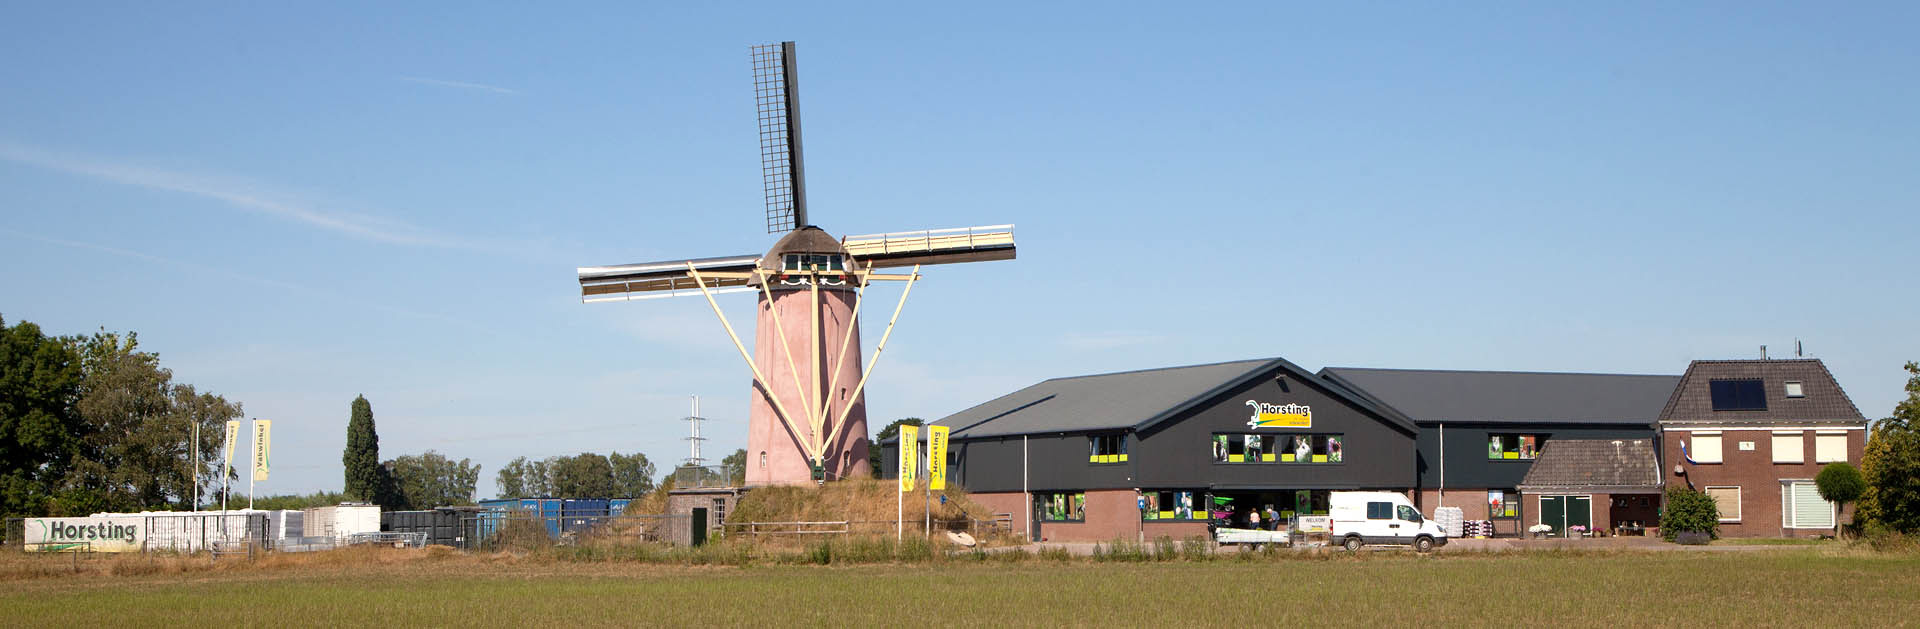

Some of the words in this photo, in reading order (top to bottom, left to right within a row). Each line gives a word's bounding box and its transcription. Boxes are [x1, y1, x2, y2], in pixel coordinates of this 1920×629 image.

[1261, 403, 1308, 417] Horsting
[257, 424, 265, 468] Vakwinkel
[932, 431, 941, 473] Horsting
[50, 520, 137, 545] Horsting
